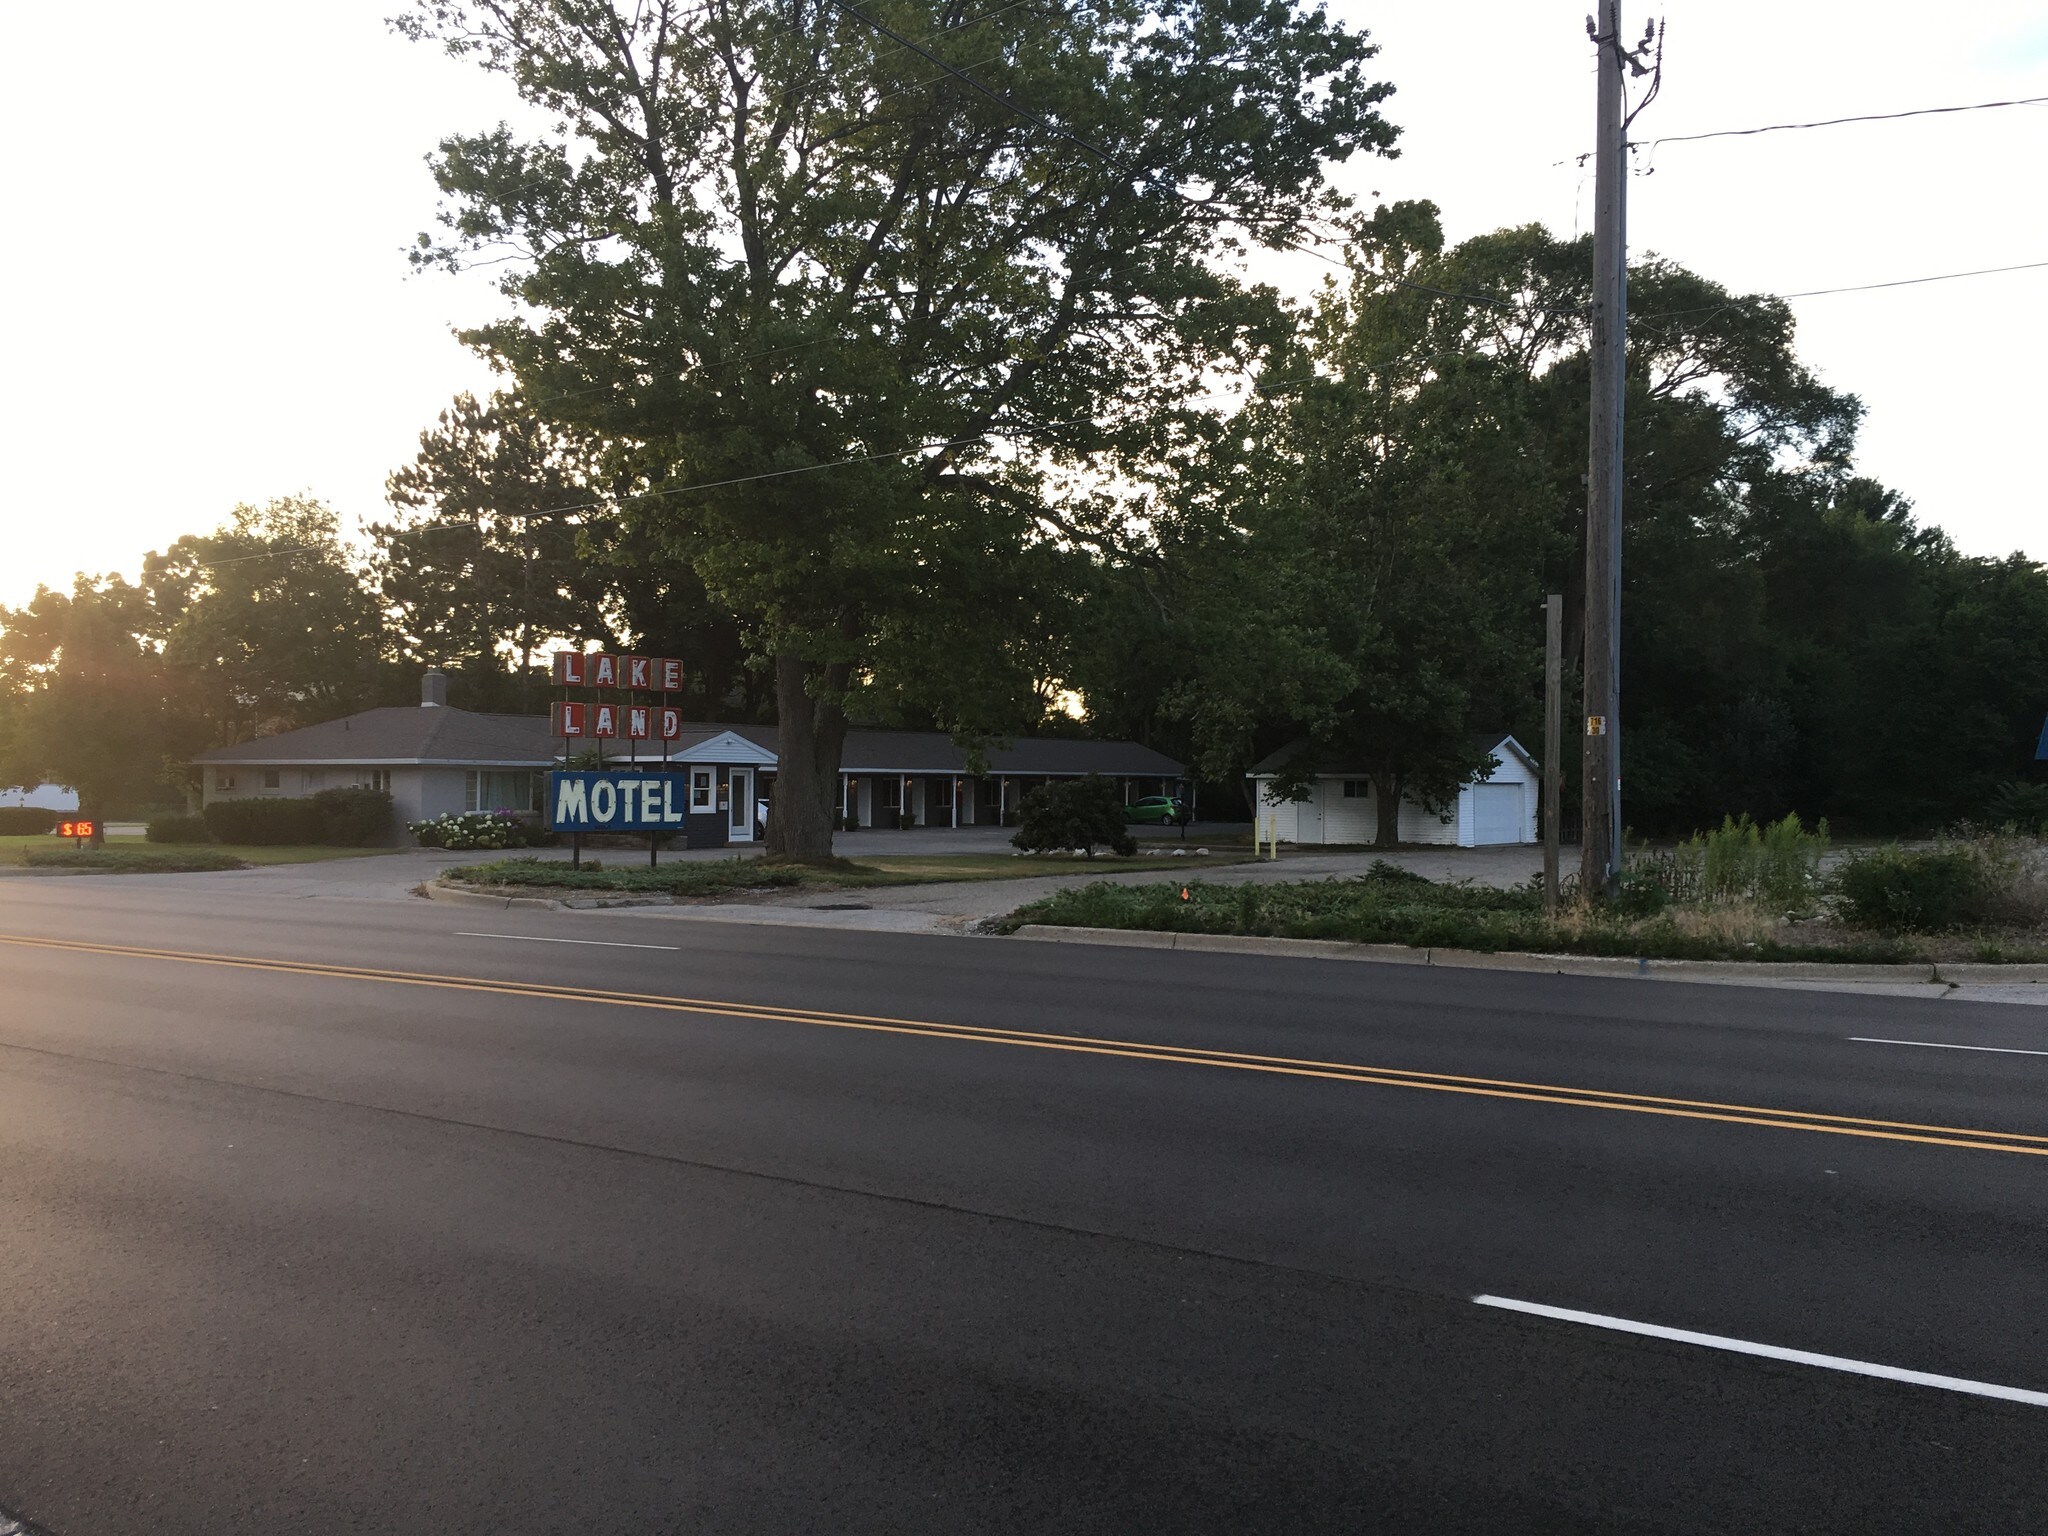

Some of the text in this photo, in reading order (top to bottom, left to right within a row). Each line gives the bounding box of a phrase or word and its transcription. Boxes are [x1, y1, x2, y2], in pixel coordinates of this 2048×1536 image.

[566, 654, 679, 689] LAKE
[565, 705, 678, 737] LAND
[556, 779, 683, 824] MOTEL
[63, 822, 92, 836] $ 65
